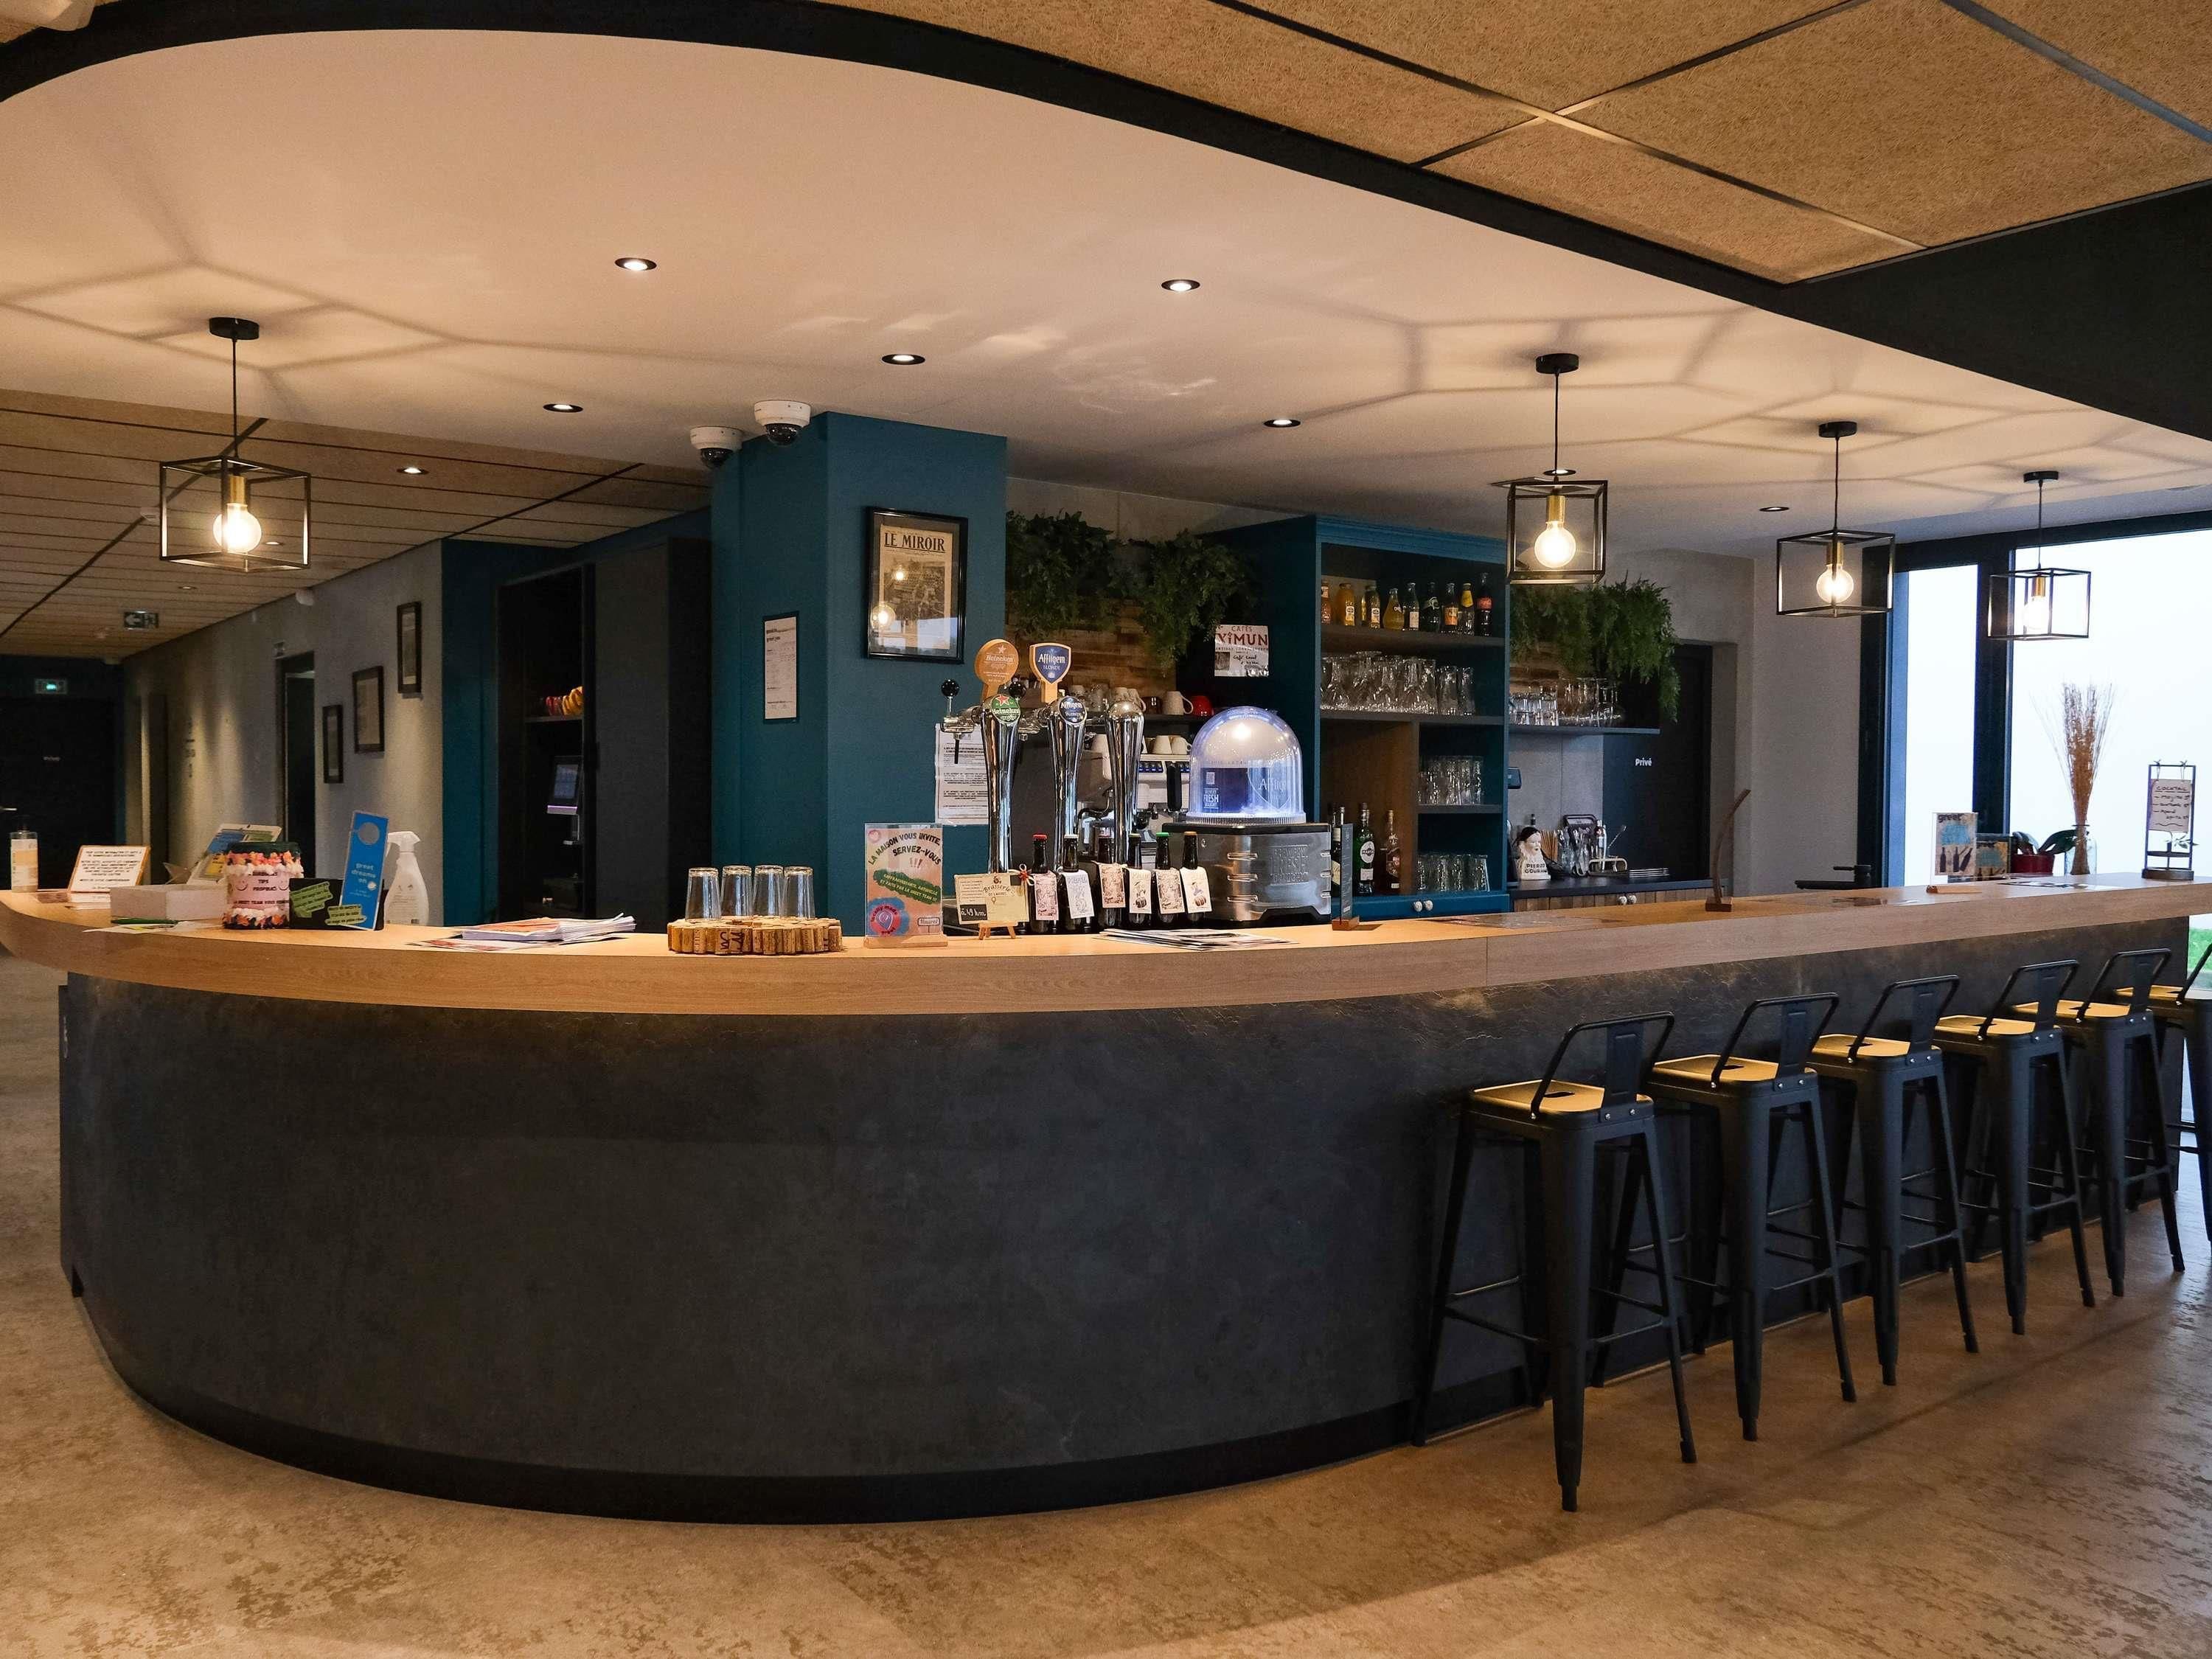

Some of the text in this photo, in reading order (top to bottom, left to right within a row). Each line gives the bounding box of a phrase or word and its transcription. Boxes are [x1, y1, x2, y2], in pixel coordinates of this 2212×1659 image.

[885, 532, 945, 552] LE MIROIR
[1037, 653, 1066, 664] Affligem
[1060, 702, 1083, 710] Affligem
[1635, 757, 1652, 767] Privé
[1203, 794, 1219, 803] FRESH
[868, 855, 878, 866] LA
[875, 836, 899, 856] MAISON
[900, 832, 917, 841] VOUS
[892, 845, 942, 865] SERVEZ-VOUS
